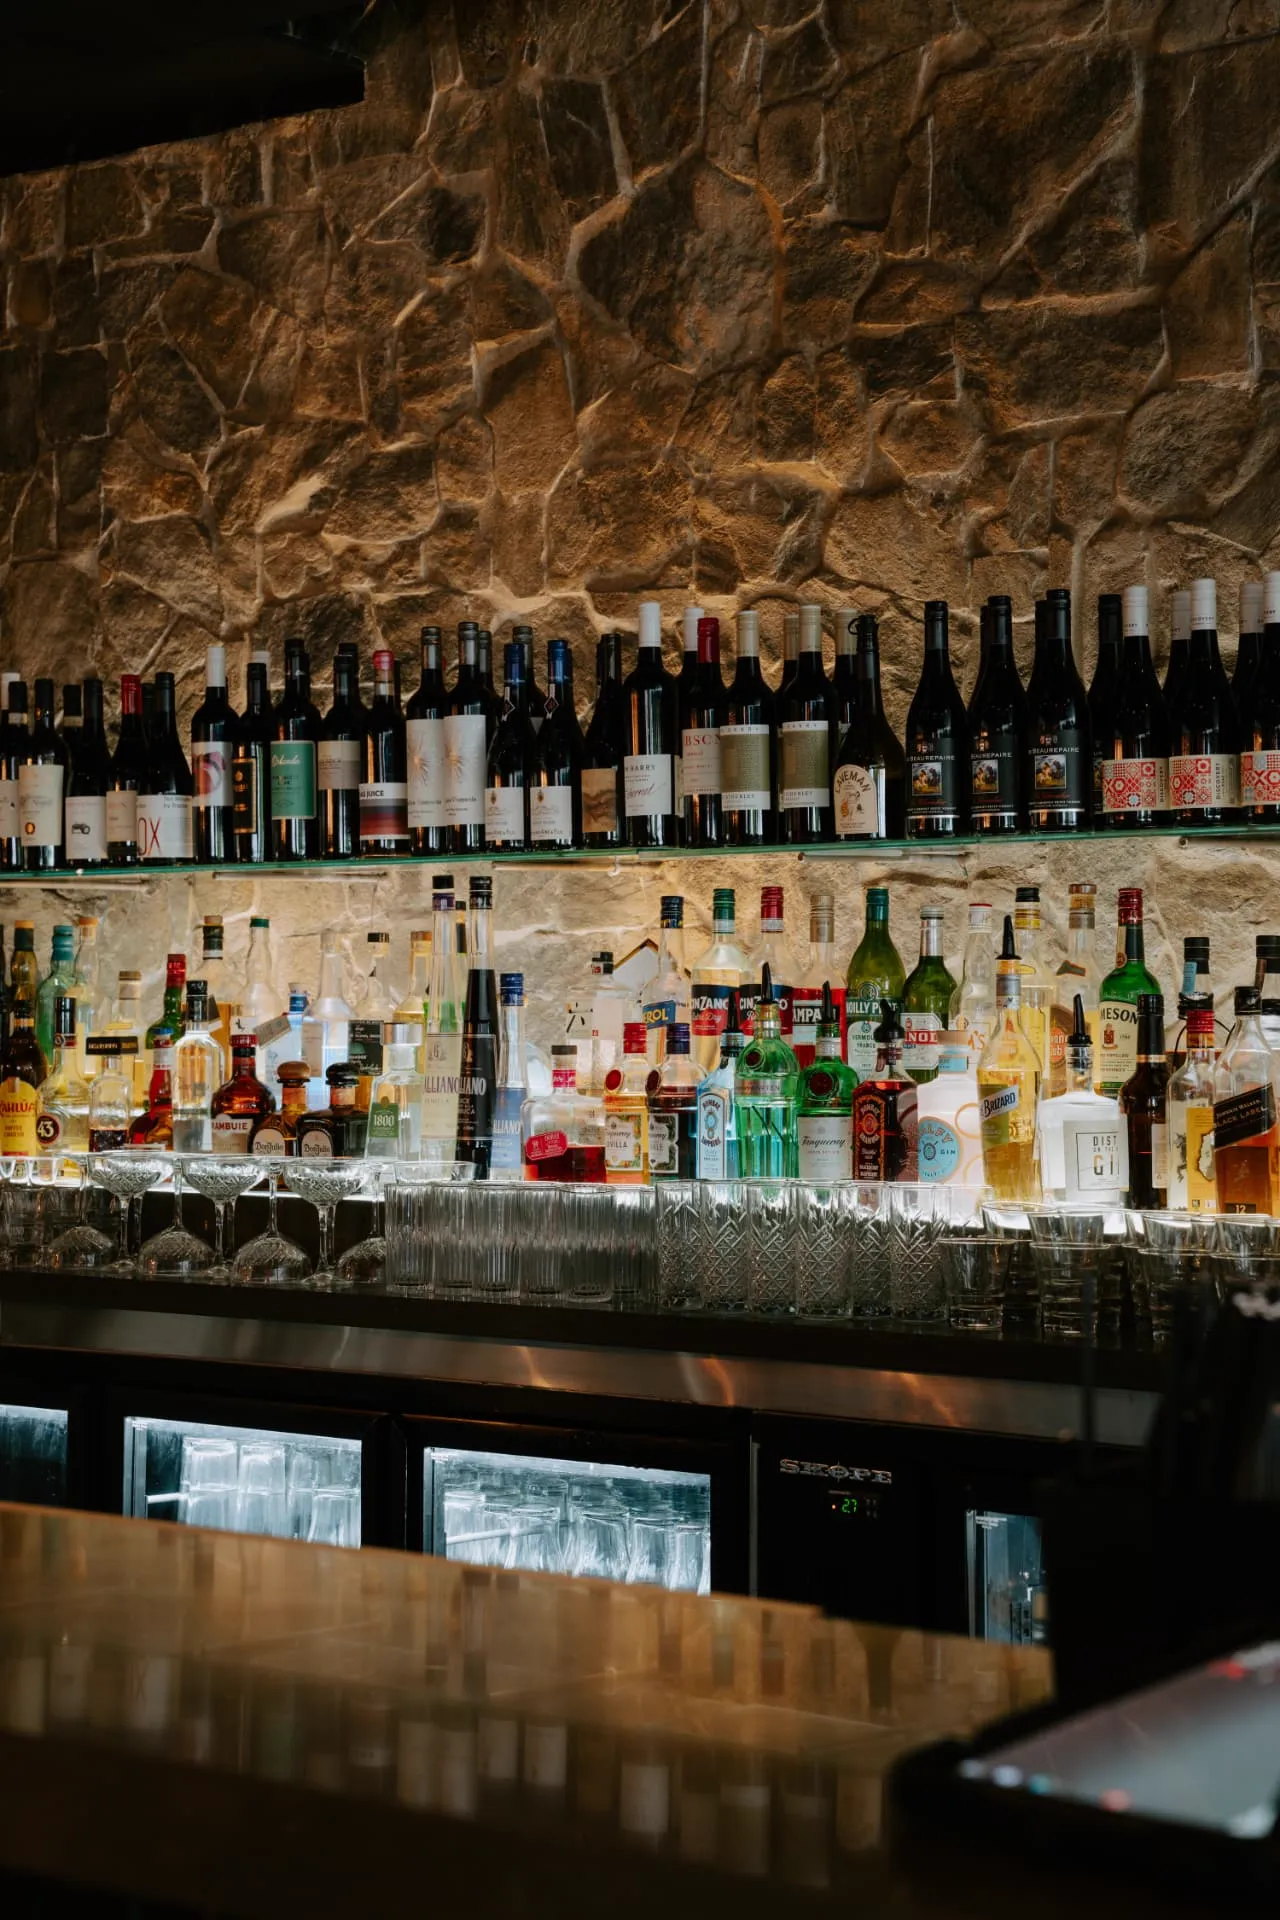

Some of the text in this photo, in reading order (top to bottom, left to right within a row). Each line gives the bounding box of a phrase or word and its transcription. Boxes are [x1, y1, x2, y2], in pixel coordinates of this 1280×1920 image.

[983, 1092, 1016, 1117] BRIZARD
[38, 1120, 55, 1137] 43
[374, 1114, 395, 1127] 1800
[801, 1135, 846, 1148] Tanqueray
[779, 1459, 893, 1484] SKOPE
